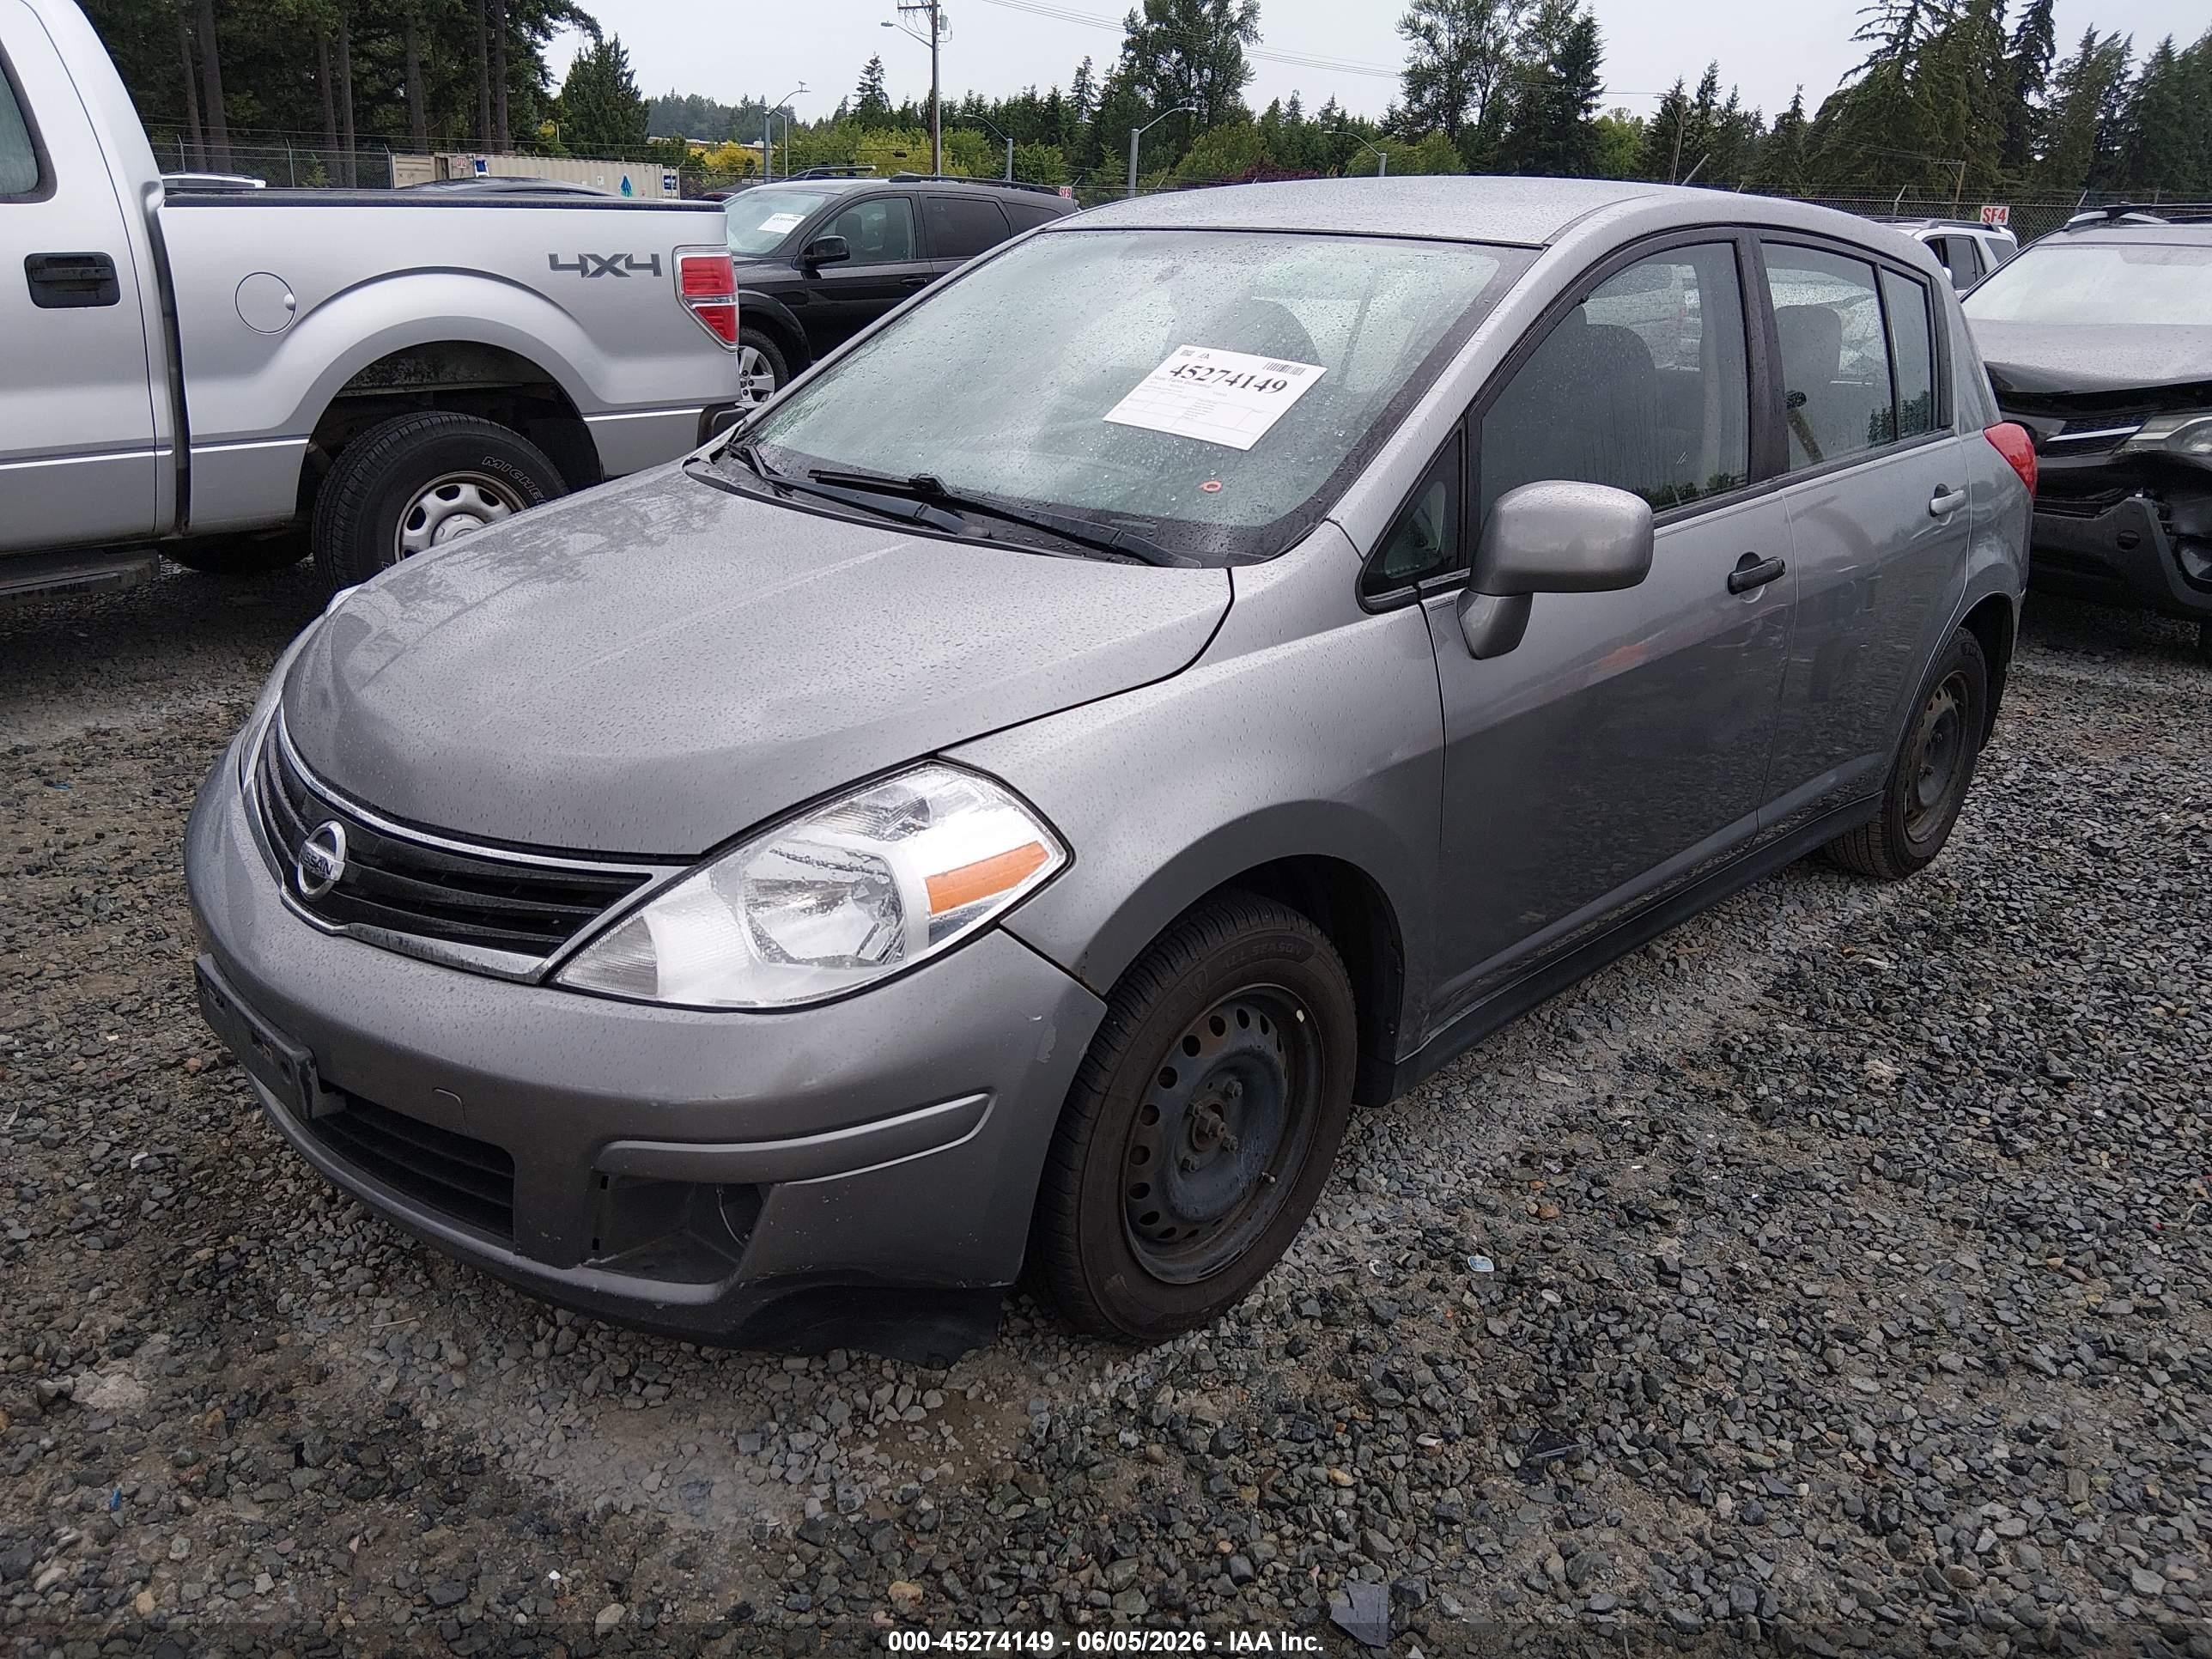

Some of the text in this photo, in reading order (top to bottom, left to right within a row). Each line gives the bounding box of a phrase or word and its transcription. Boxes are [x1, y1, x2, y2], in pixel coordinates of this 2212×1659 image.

[1060, 187, 1072, 198] SF9
[1982, 207, 2008, 223] SF4
[548, 253, 663, 278] 4X4
[1169, 363, 1288, 394] 45274149
[1251, 942, 1303, 957] SEASON
